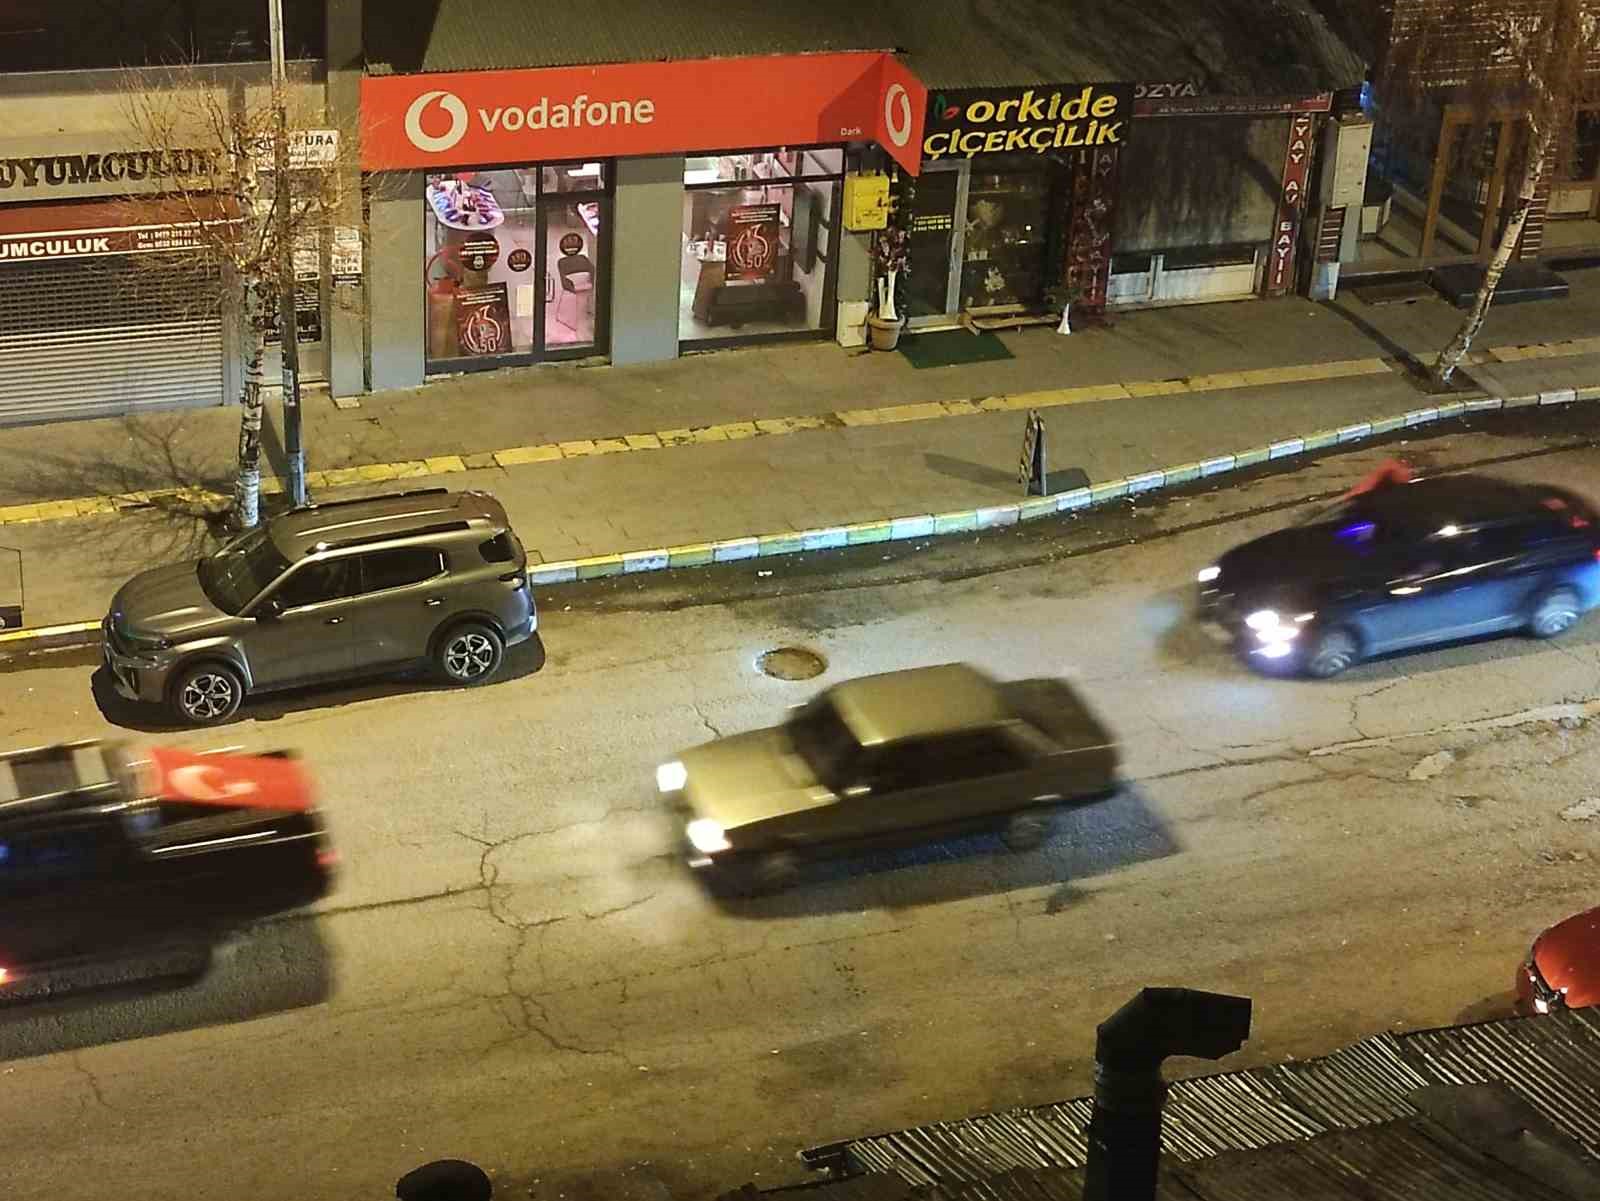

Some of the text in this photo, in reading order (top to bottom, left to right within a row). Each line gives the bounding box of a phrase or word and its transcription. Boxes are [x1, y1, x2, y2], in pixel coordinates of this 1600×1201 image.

[479, 95, 655, 133] vodafone
[966, 87, 1118, 121] orkide
[840, 126, 862, 136] Dark
